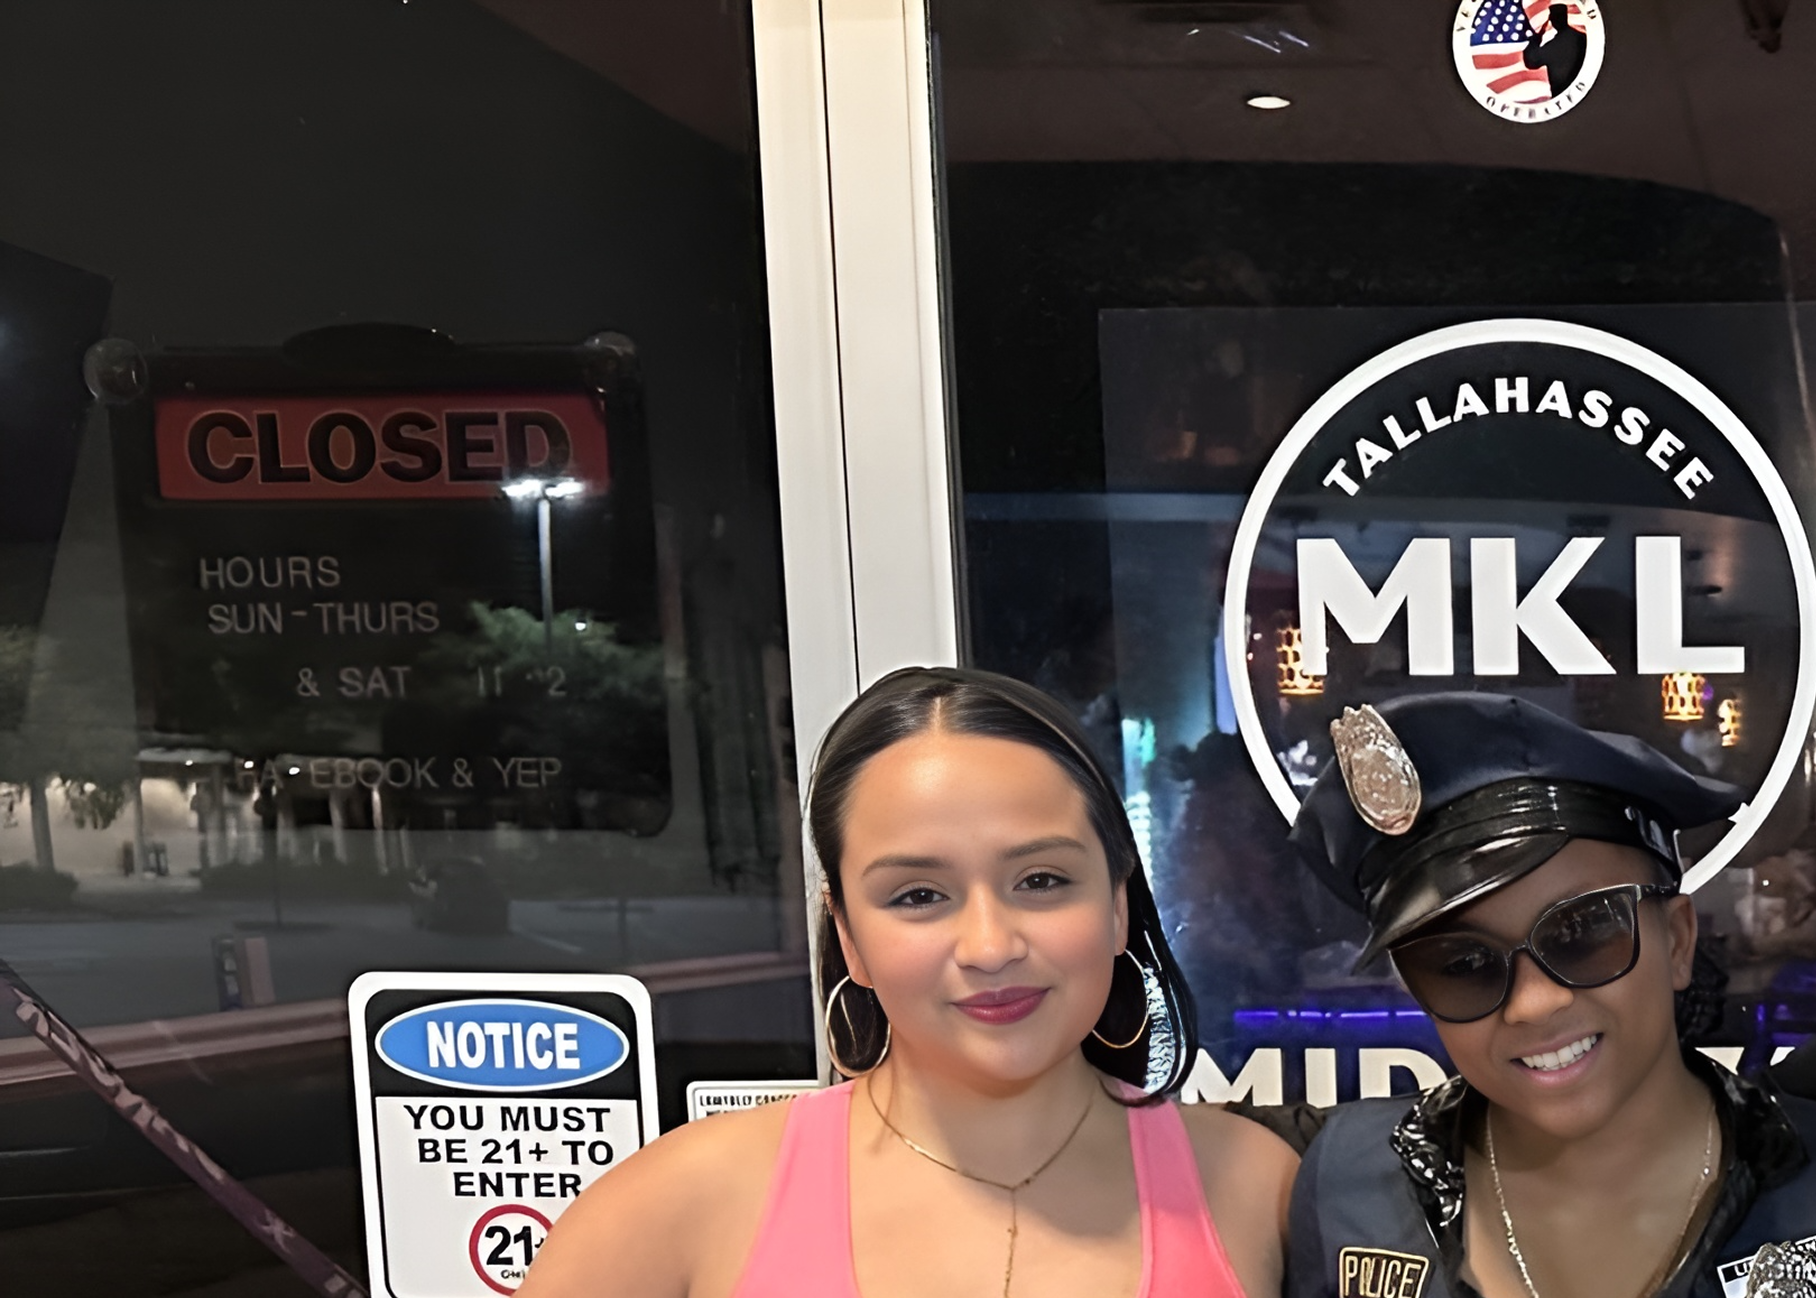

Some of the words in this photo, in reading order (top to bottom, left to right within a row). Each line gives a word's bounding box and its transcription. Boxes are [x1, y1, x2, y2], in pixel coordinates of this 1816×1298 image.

[187, 410, 573, 483] CLOSED
[1322, 376, 1714, 499] TALLAHASSEE
[199, 556, 341, 590] HOURS
[1295, 536, 1746, 677] MKL
[297, 667, 320, 697] &
[338, 666, 412, 697] SAT
[452, 758, 474, 789] &
[494, 757, 563, 789] YEP
[426, 1021, 581, 1070] NOTICE
[403, 1105, 484, 1130] YOU
[500, 1106, 611, 1132] MUST
[418, 1138, 468, 1163] BE
[481, 1138, 549, 1164] 21+
[562, 1140, 614, 1165] TO
[453, 1172, 582, 1198] ENTER
